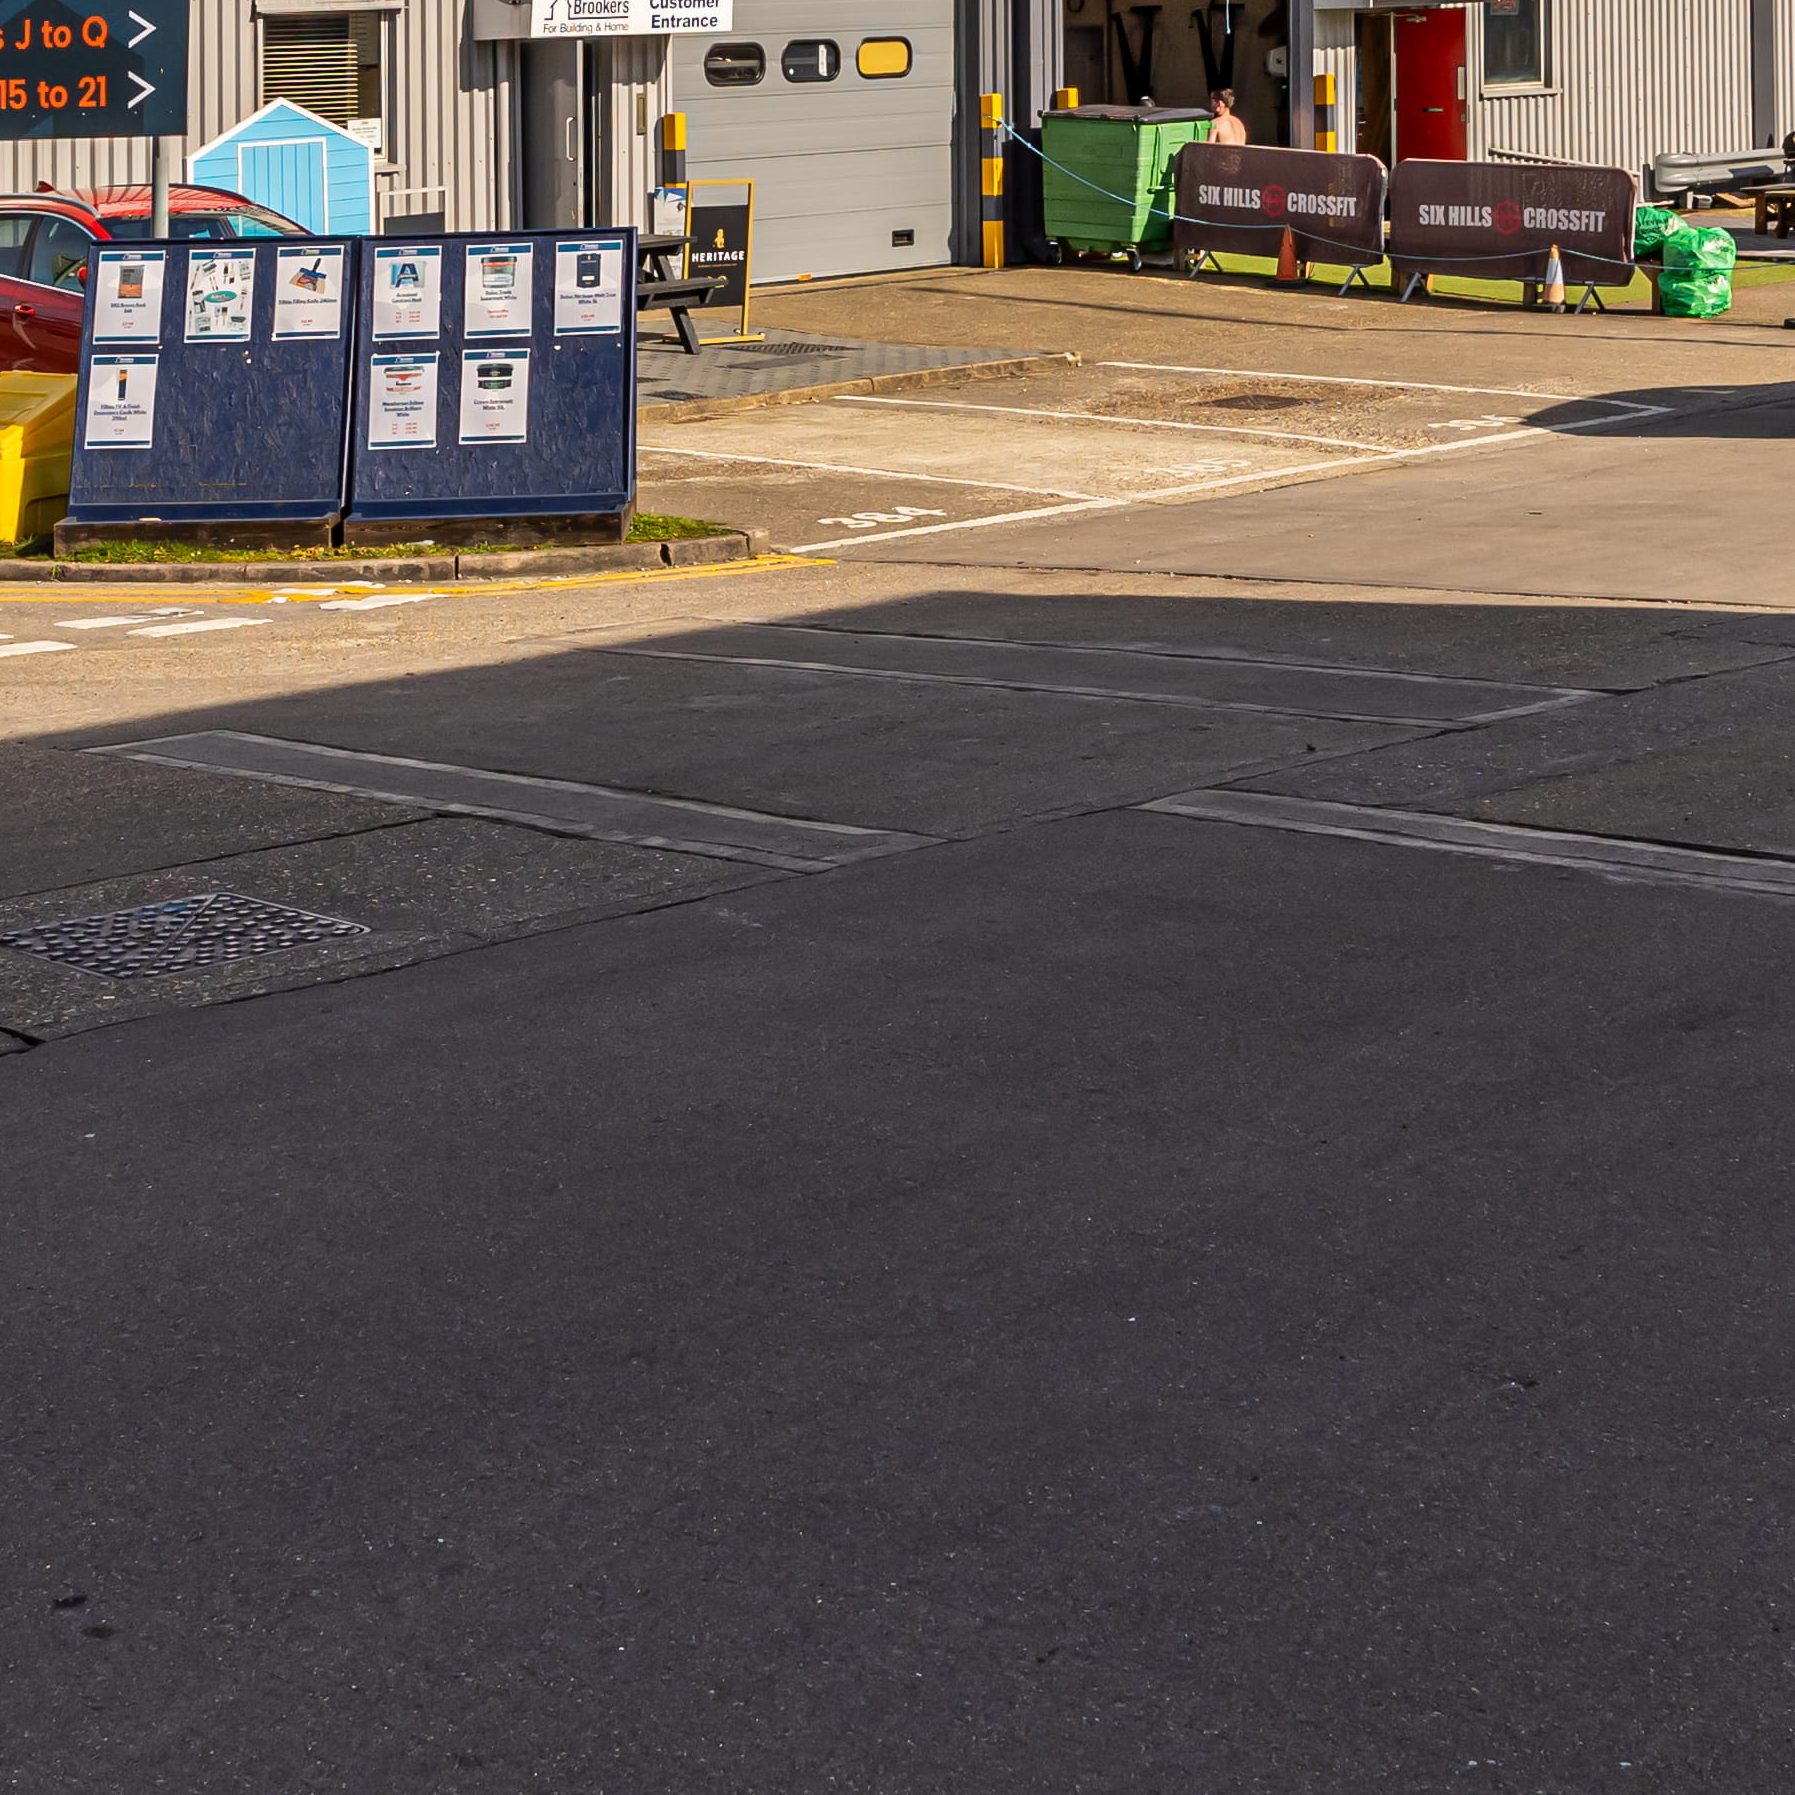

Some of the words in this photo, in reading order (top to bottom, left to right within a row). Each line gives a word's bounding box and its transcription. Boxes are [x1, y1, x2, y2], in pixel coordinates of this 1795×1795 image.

[14, 19, 32, 50] J
[41, 20, 72, 49] to
[82, 15, 109, 49] Q
[543, 23, 557, 34] For
[559, 22, 593, 35] Building
[595, 22, 601, 32] &
[604, 22, 630, 32] Home
[651, 14, 719, 29] Entrance
[37, 80, 68, 110] to
[77, 75, 108, 108] 21
[1198, 184, 1221, 207] SIX
[1223, 187, 1261, 210] HILLS
[1287, 192, 1357, 217] CROSSFIT
[1419, 204, 1446, 226] SIX
[1448, 205, 1493, 227] HILLS
[1523, 207, 1606, 233] CROSSFIT
[691, 250, 745, 263] HERITAGE
